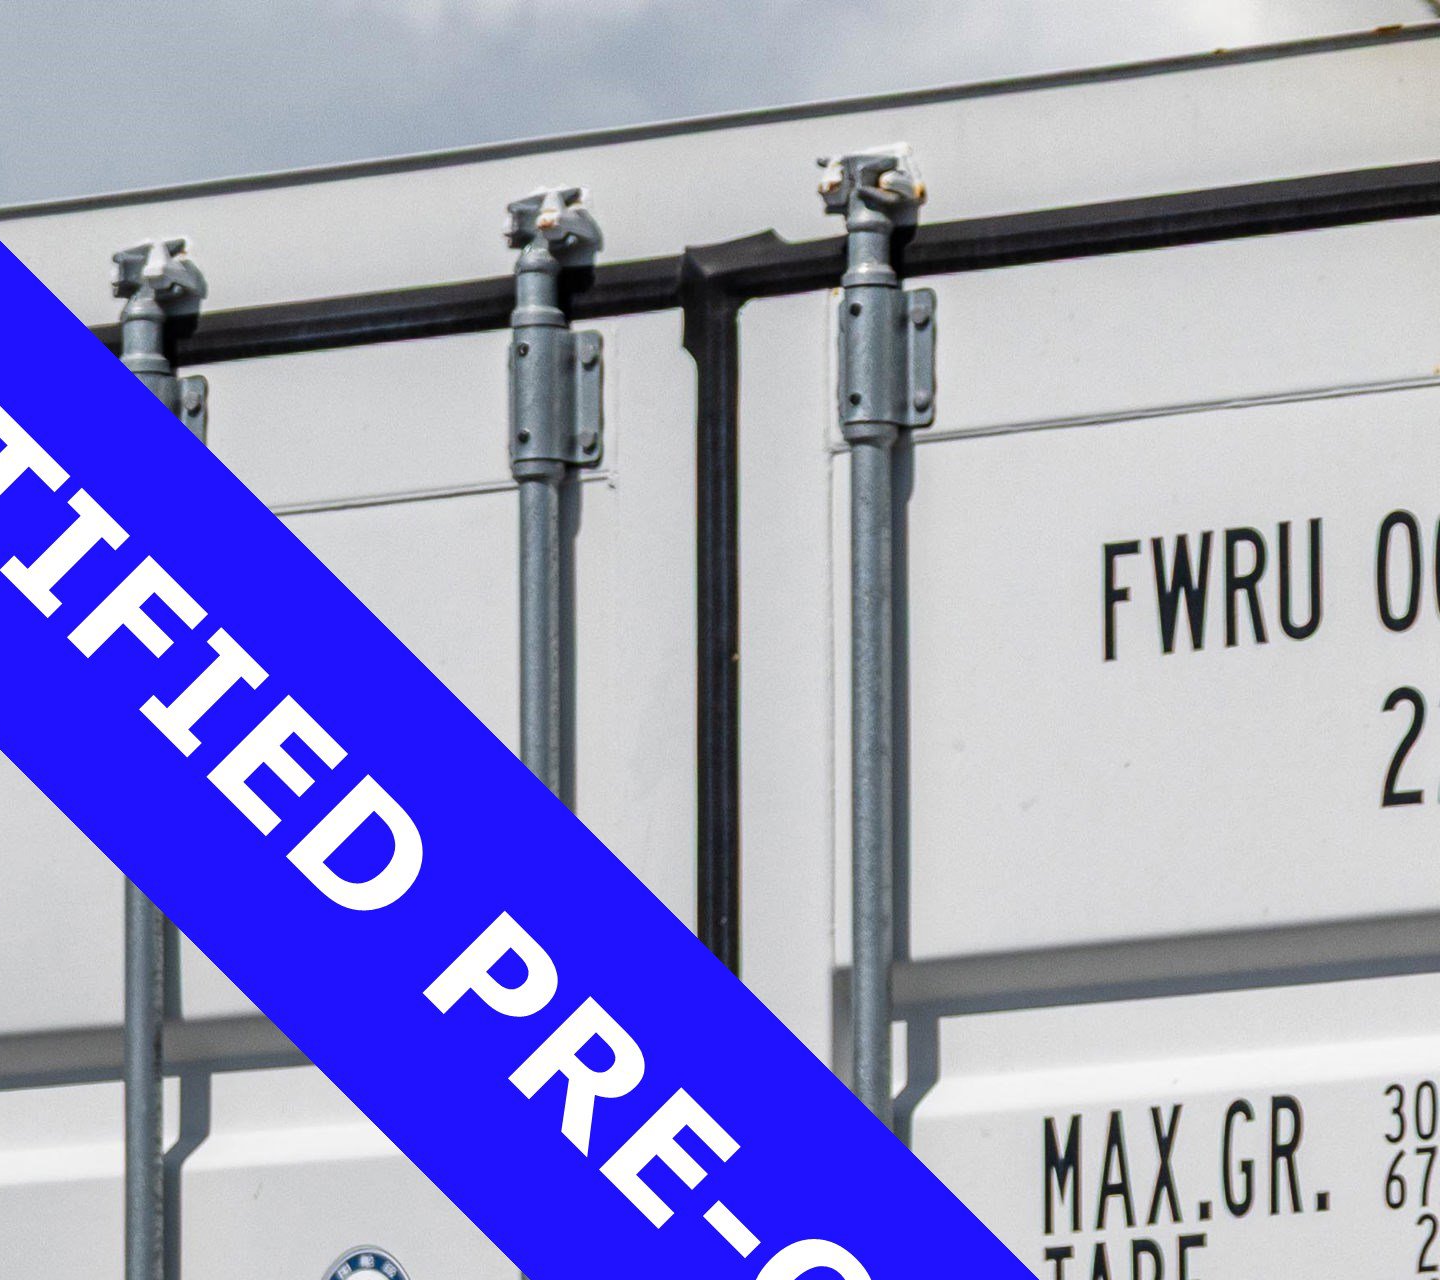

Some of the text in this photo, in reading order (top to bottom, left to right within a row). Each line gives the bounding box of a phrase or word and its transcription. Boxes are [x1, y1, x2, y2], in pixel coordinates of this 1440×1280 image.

[1101, 508, 1440, 663] FWRU 0
[1043, 1080, 1439, 1235] MAX.GR. 30
[1385, 1146, 1439, 1210] 67
